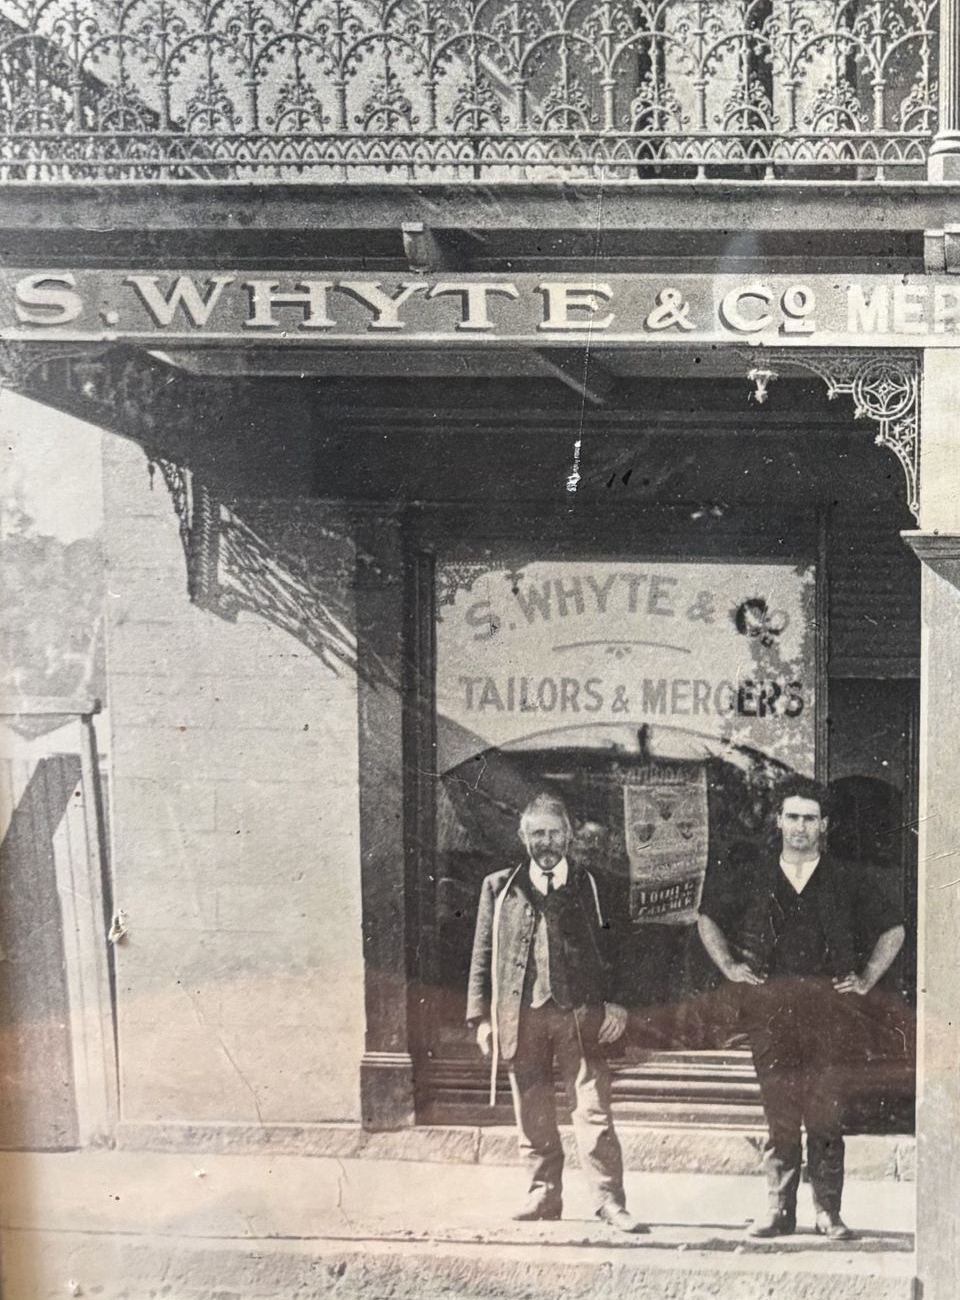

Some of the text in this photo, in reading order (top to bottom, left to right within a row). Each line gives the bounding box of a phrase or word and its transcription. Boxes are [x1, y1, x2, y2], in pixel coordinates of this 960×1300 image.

[643, 287, 698, 331] &
[686, 590, 716, 624] &
[458, 675, 805, 718] TAILORS & MERCERS
